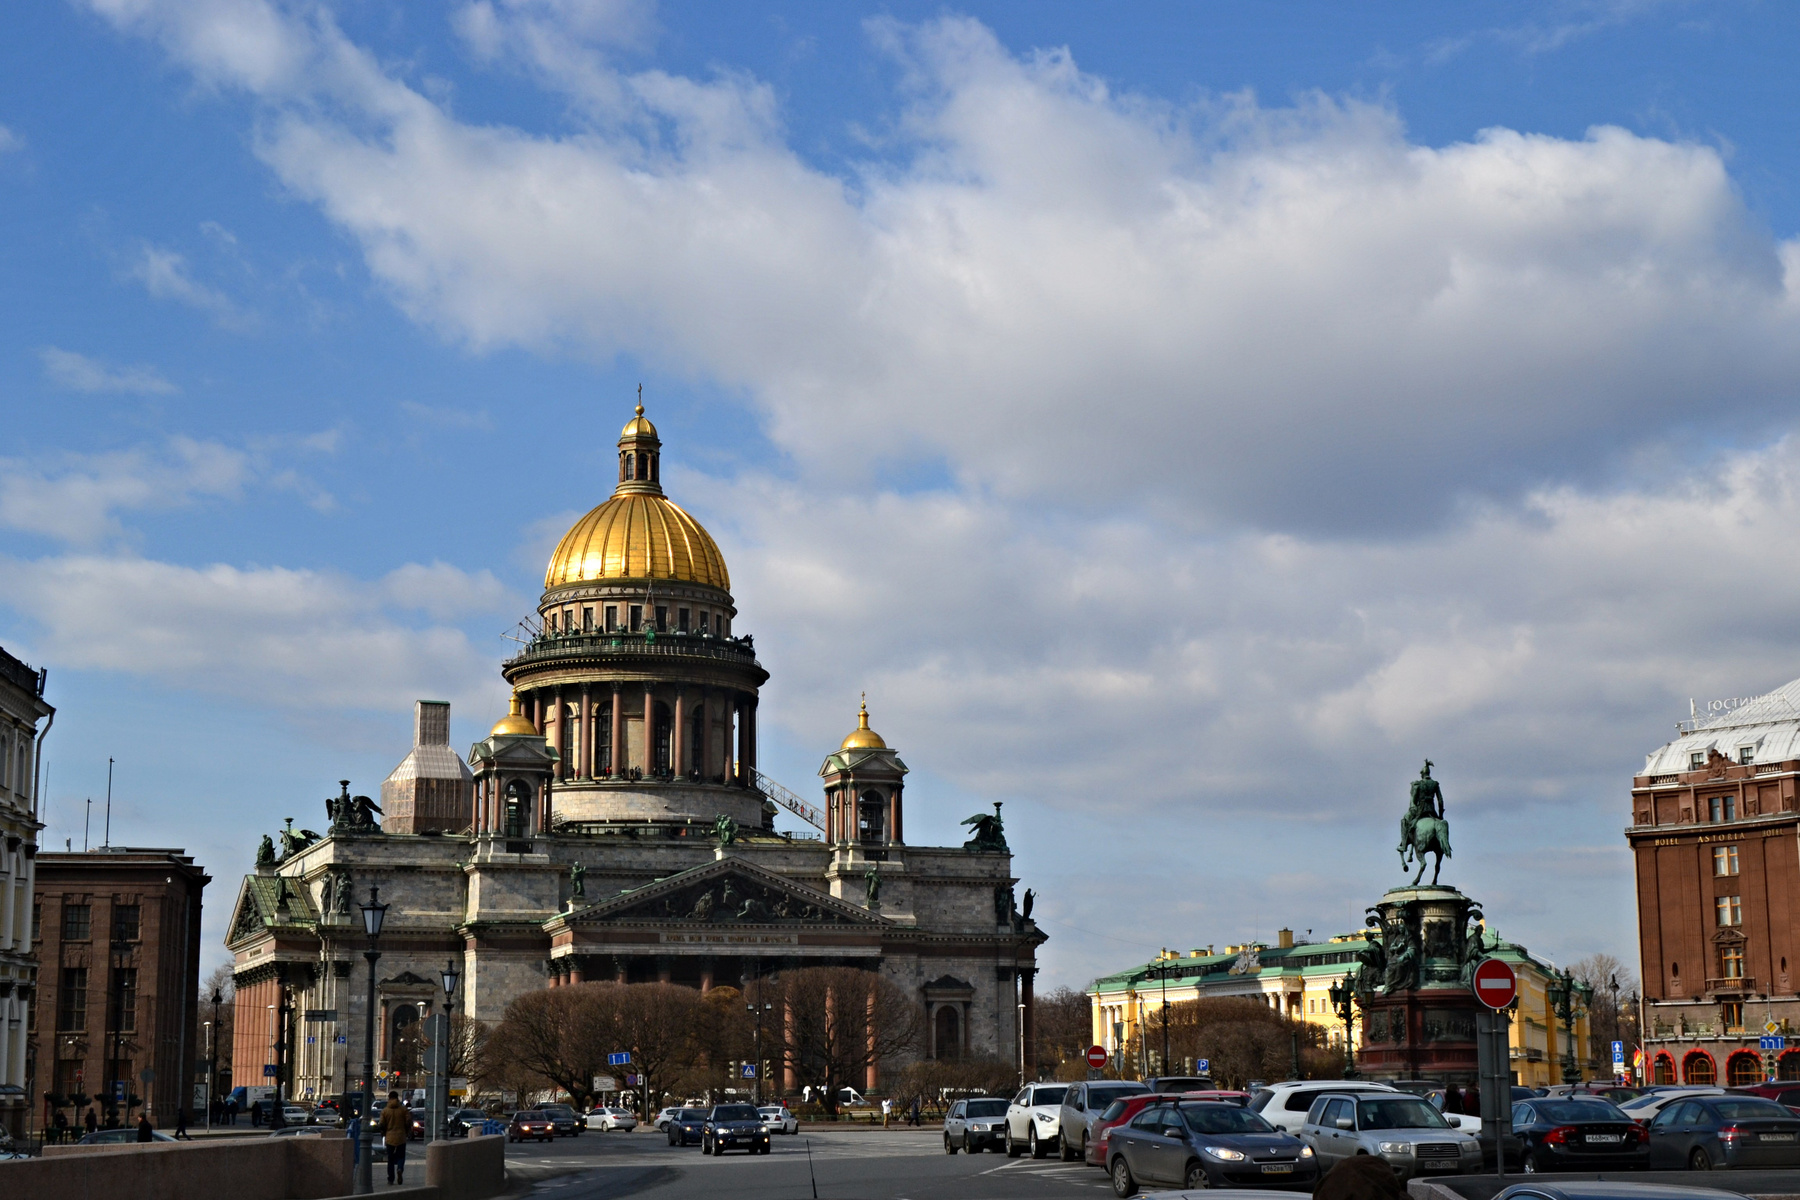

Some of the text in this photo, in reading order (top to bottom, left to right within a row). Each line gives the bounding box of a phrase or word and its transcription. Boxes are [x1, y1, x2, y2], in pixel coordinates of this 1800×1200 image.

[1707, 693, 1787, 711] ГОСТИНИЦА
[1655, 837, 1679, 846] HOTEL
[1697, 832, 1745, 843] ASTORIA
[1615, 1053, 1622, 1062] P
[1200, 1060, 1207, 1070] P
